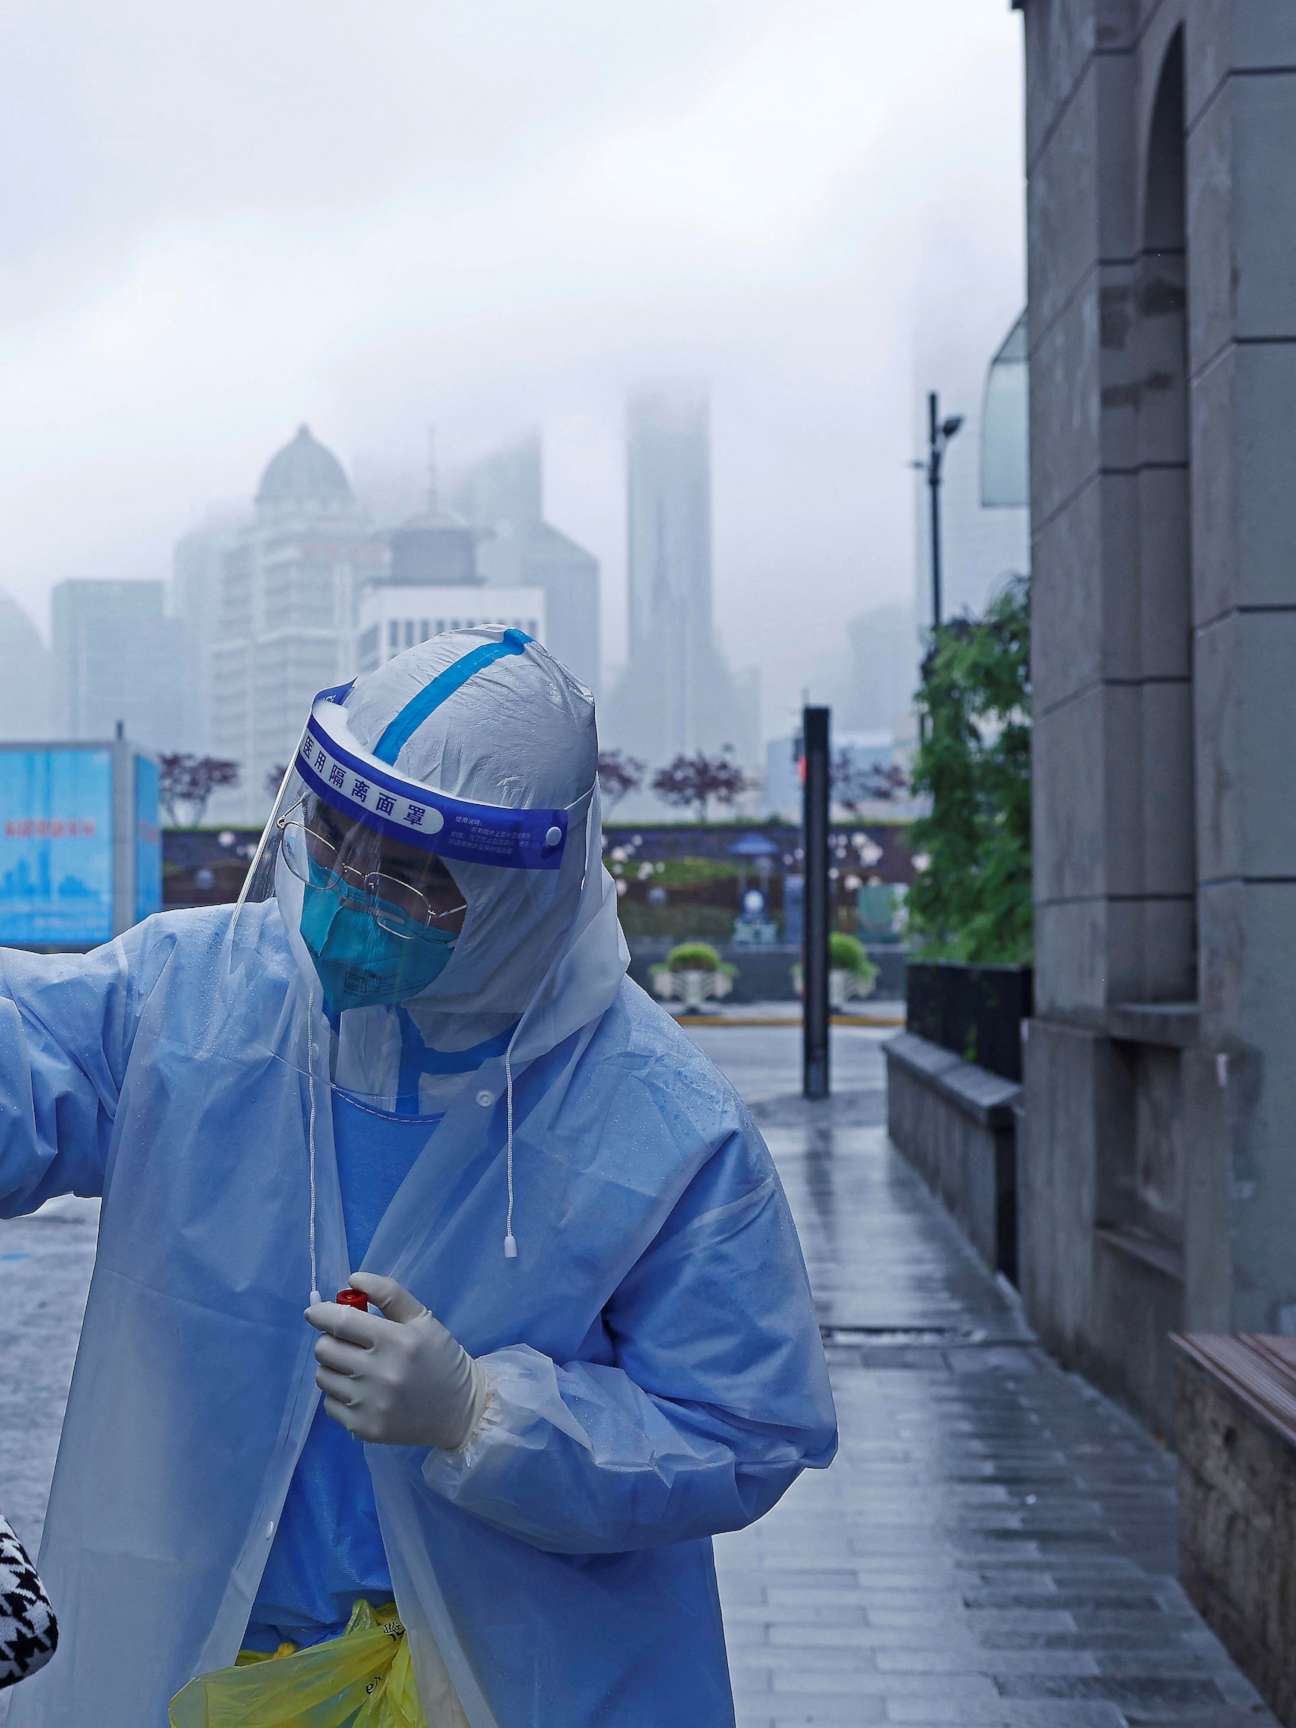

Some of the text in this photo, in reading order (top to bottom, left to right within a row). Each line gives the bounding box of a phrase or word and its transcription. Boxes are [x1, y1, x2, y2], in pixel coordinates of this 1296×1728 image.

[302, 735, 426, 826] 医用隔离面罩
